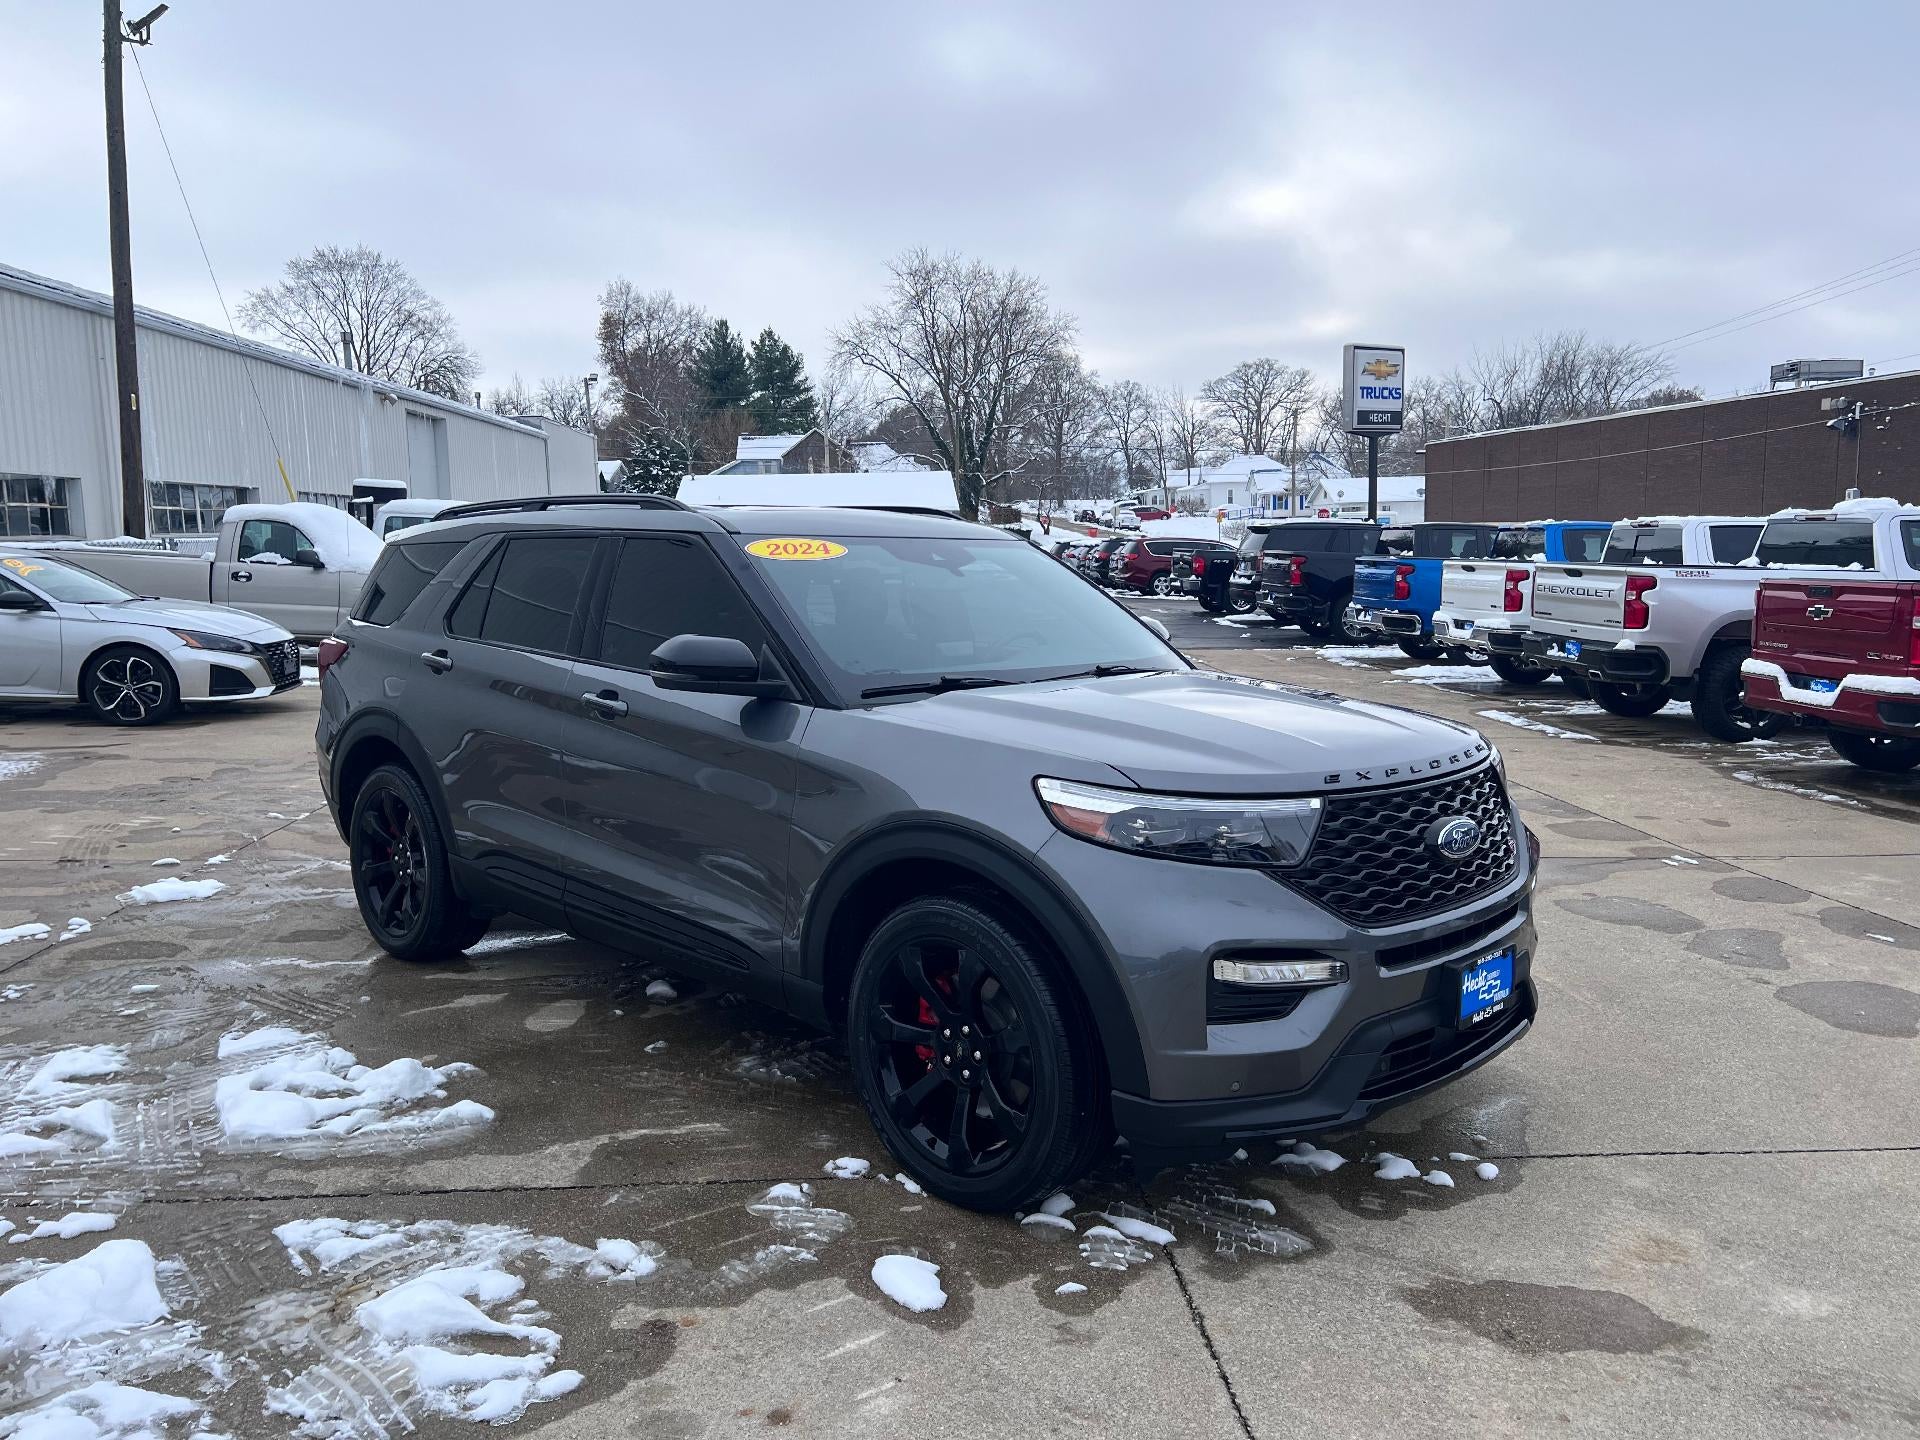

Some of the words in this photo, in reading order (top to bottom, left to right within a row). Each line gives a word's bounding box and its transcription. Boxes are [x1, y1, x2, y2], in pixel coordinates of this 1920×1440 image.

[1360, 386, 1402, 400] TRUCKS
[1369, 413, 1391, 423] HECHT
[767, 542, 831, 556] 2024
[1537, 584, 1615, 599] CHEVROLET
[1324, 743, 1486, 785] EXPLORER
[1462, 968, 1488, 996] Hecht
